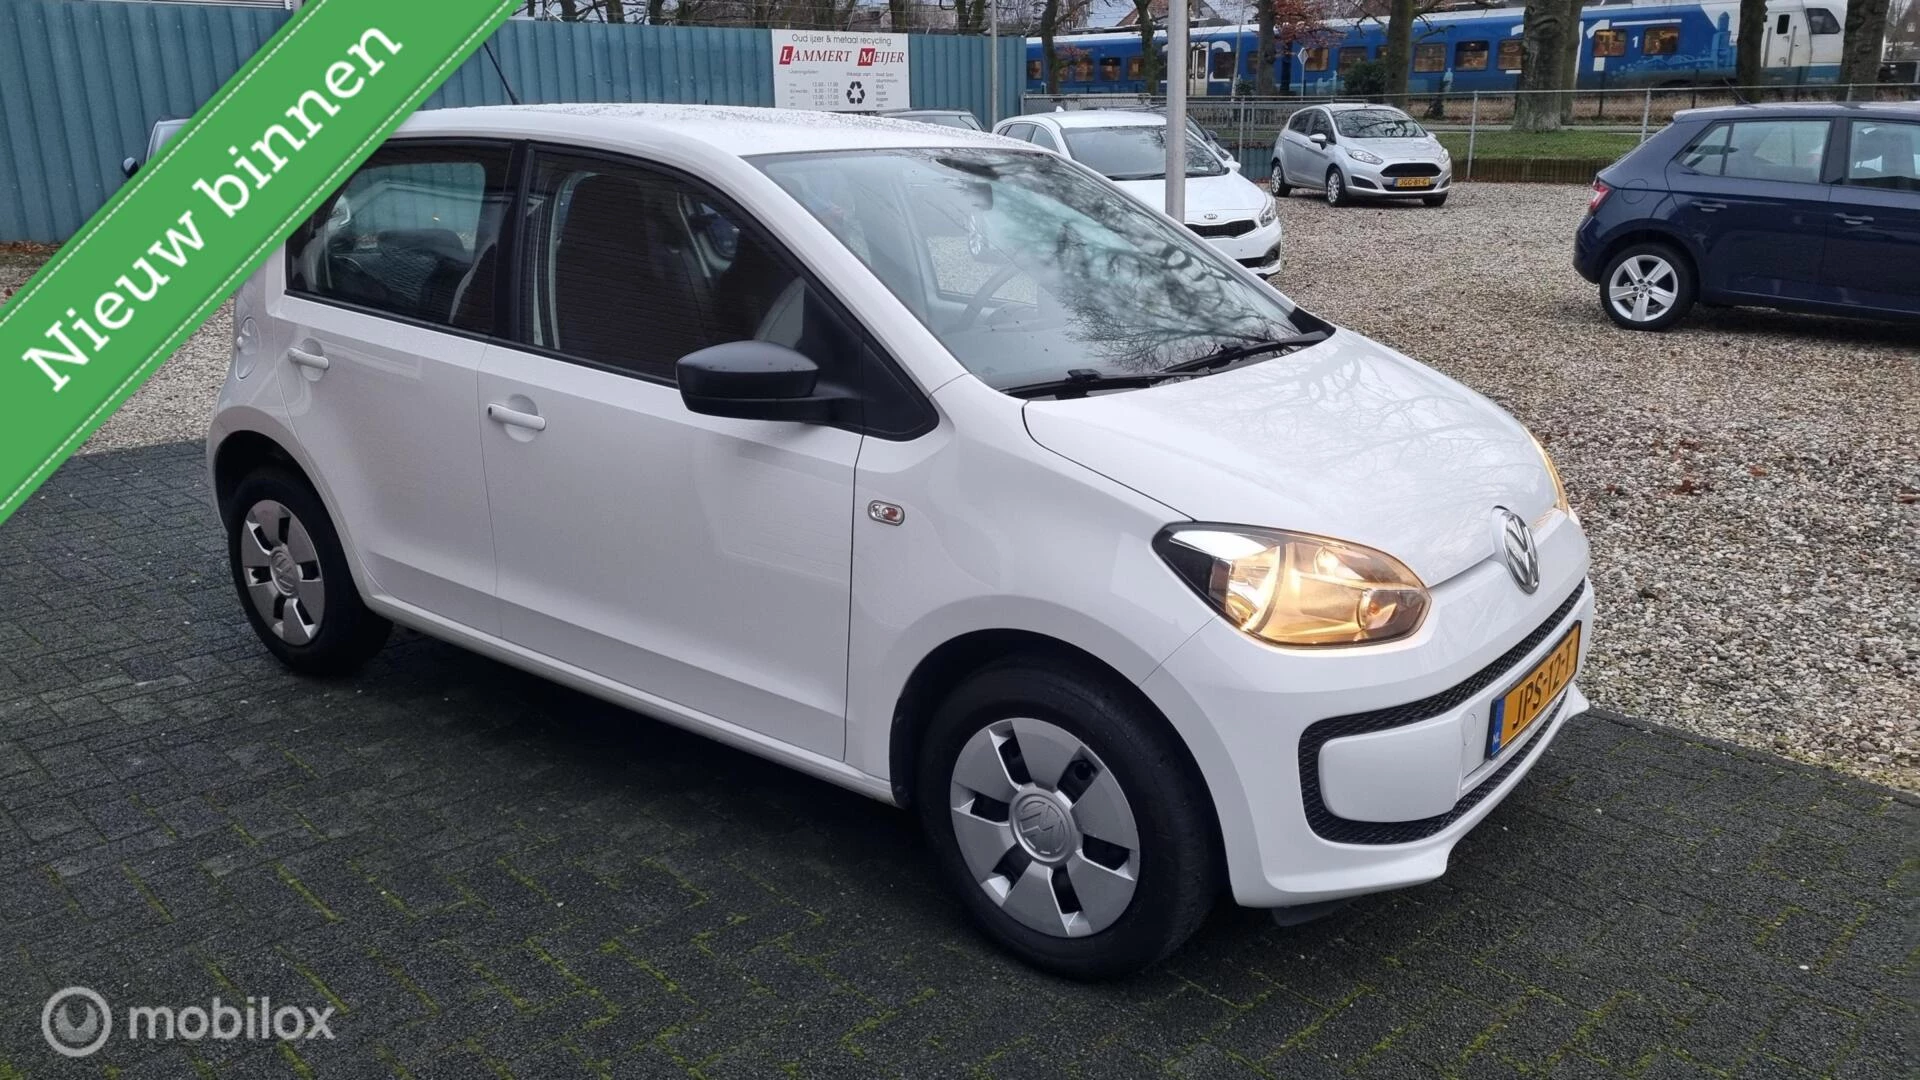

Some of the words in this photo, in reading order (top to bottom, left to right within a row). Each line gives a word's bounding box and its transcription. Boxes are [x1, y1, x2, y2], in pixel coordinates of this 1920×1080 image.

[791, 34, 808, 43] Oud
[810, 35, 824, 45] ijzer
[826, 35, 831, 43] &
[833, 35, 858, 44] metaal
[860, 37, 892, 46] recycling
[1632, 36, 1639, 48] 1
[781, 48, 852, 63] LAMMERT
[860, 50, 904, 65] MEIJER
[1512, 639, 1574, 730] JPS-12-T
